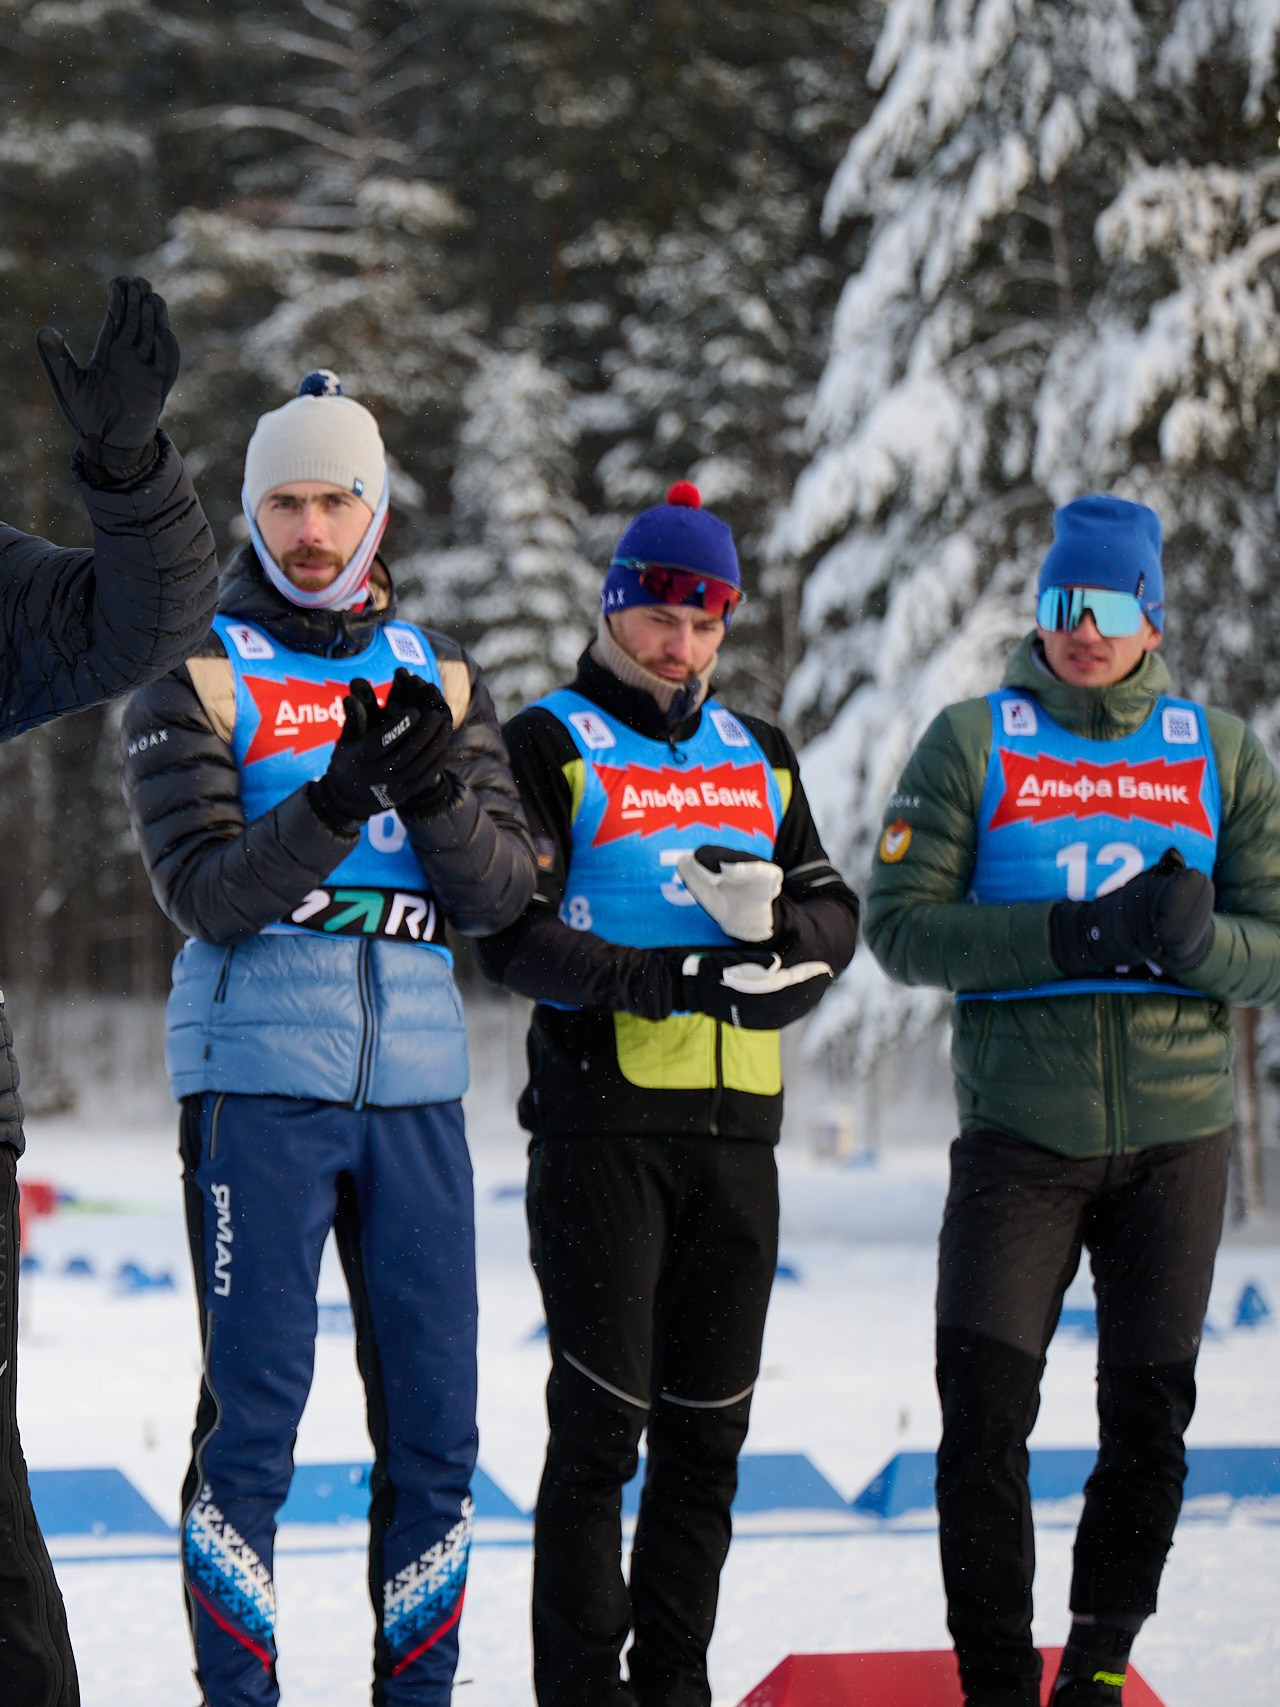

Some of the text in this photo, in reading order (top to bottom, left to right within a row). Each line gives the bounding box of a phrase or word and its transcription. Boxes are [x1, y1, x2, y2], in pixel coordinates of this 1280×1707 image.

[275, 696, 347, 728] Альф
[128, 729, 168, 758] MOAX
[621, 782, 762, 813] Альфа Банк
[1020, 774, 1190, 804] Альфа Банк
[1056, 842, 1144, 901] 12
